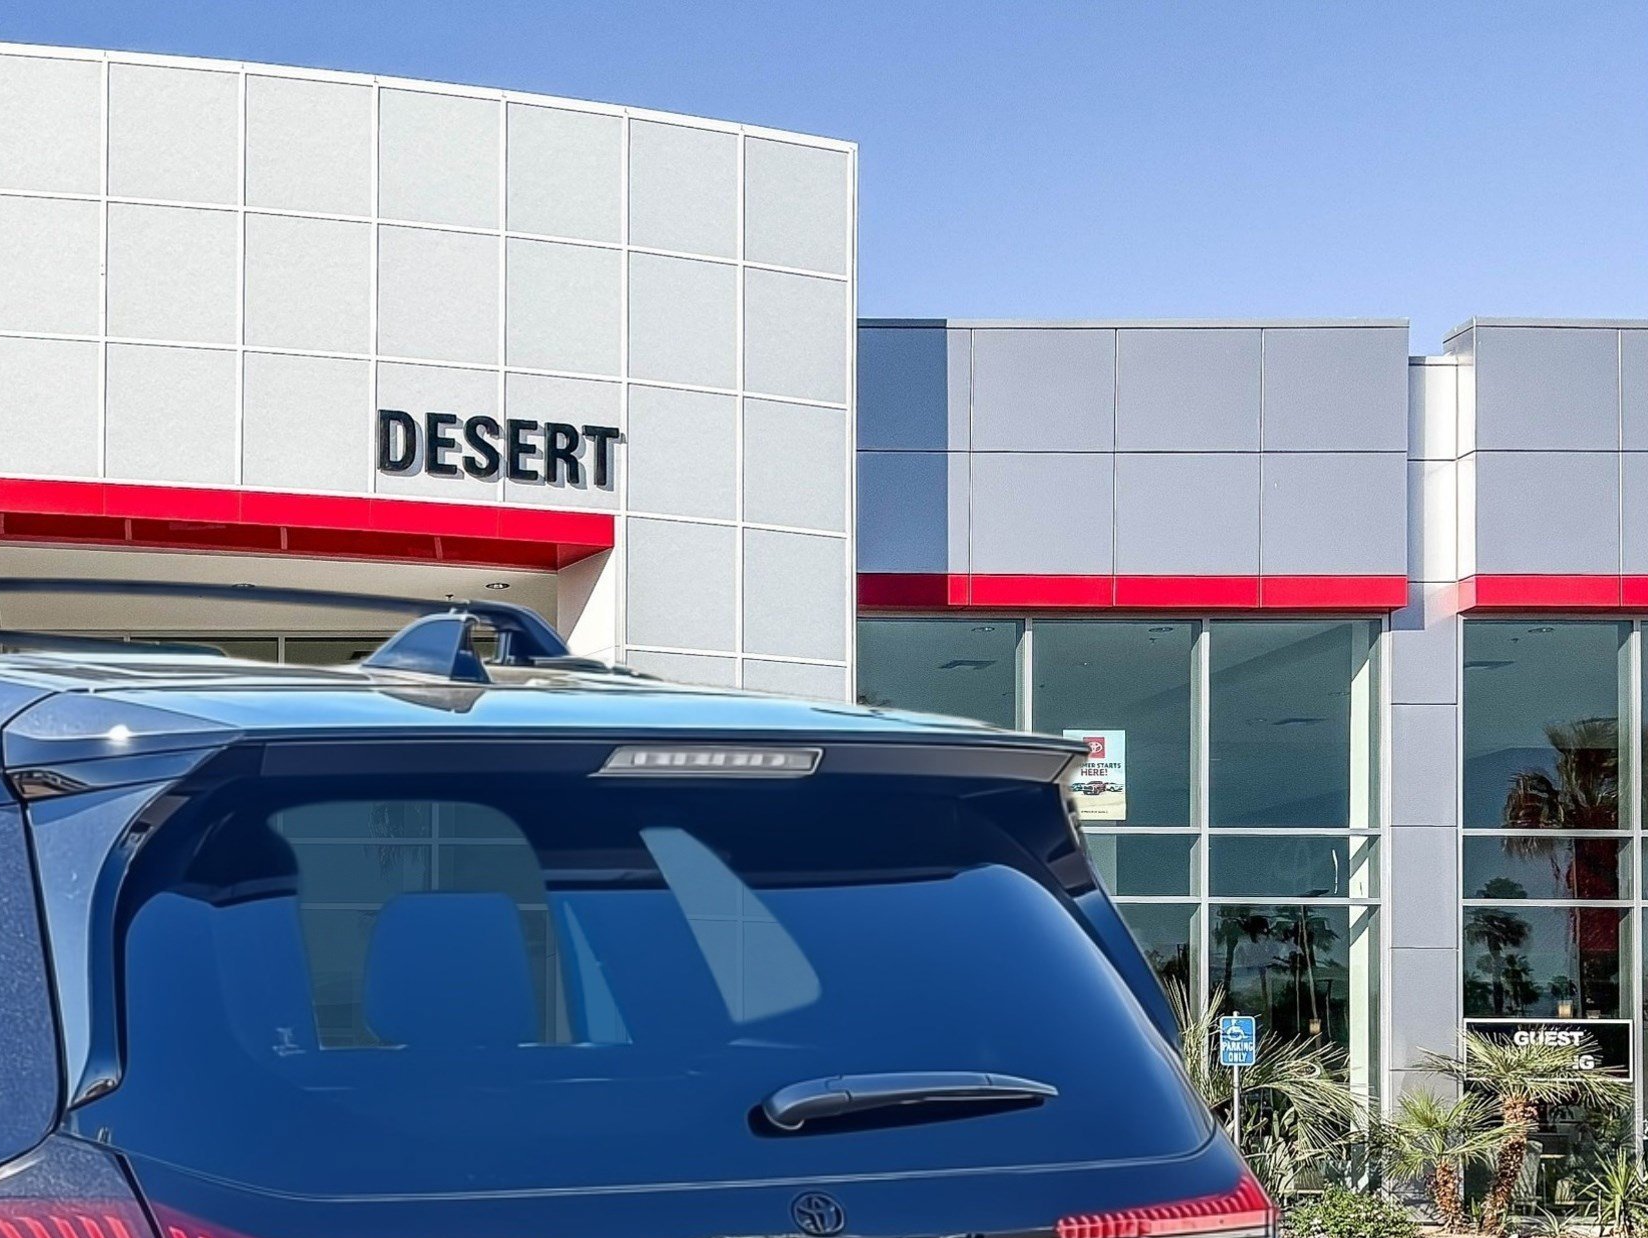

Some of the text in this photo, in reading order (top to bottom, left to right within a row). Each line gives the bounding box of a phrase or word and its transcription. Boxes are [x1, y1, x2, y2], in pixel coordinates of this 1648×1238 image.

[377, 409, 620, 487] DESERT
[1080, 768, 1108, 776] HERE!
[1513, 1031, 1584, 1047] GUEST
[1221, 1041, 1254, 1051] PARKING
[1228, 1052, 1248, 1062] ONLY
